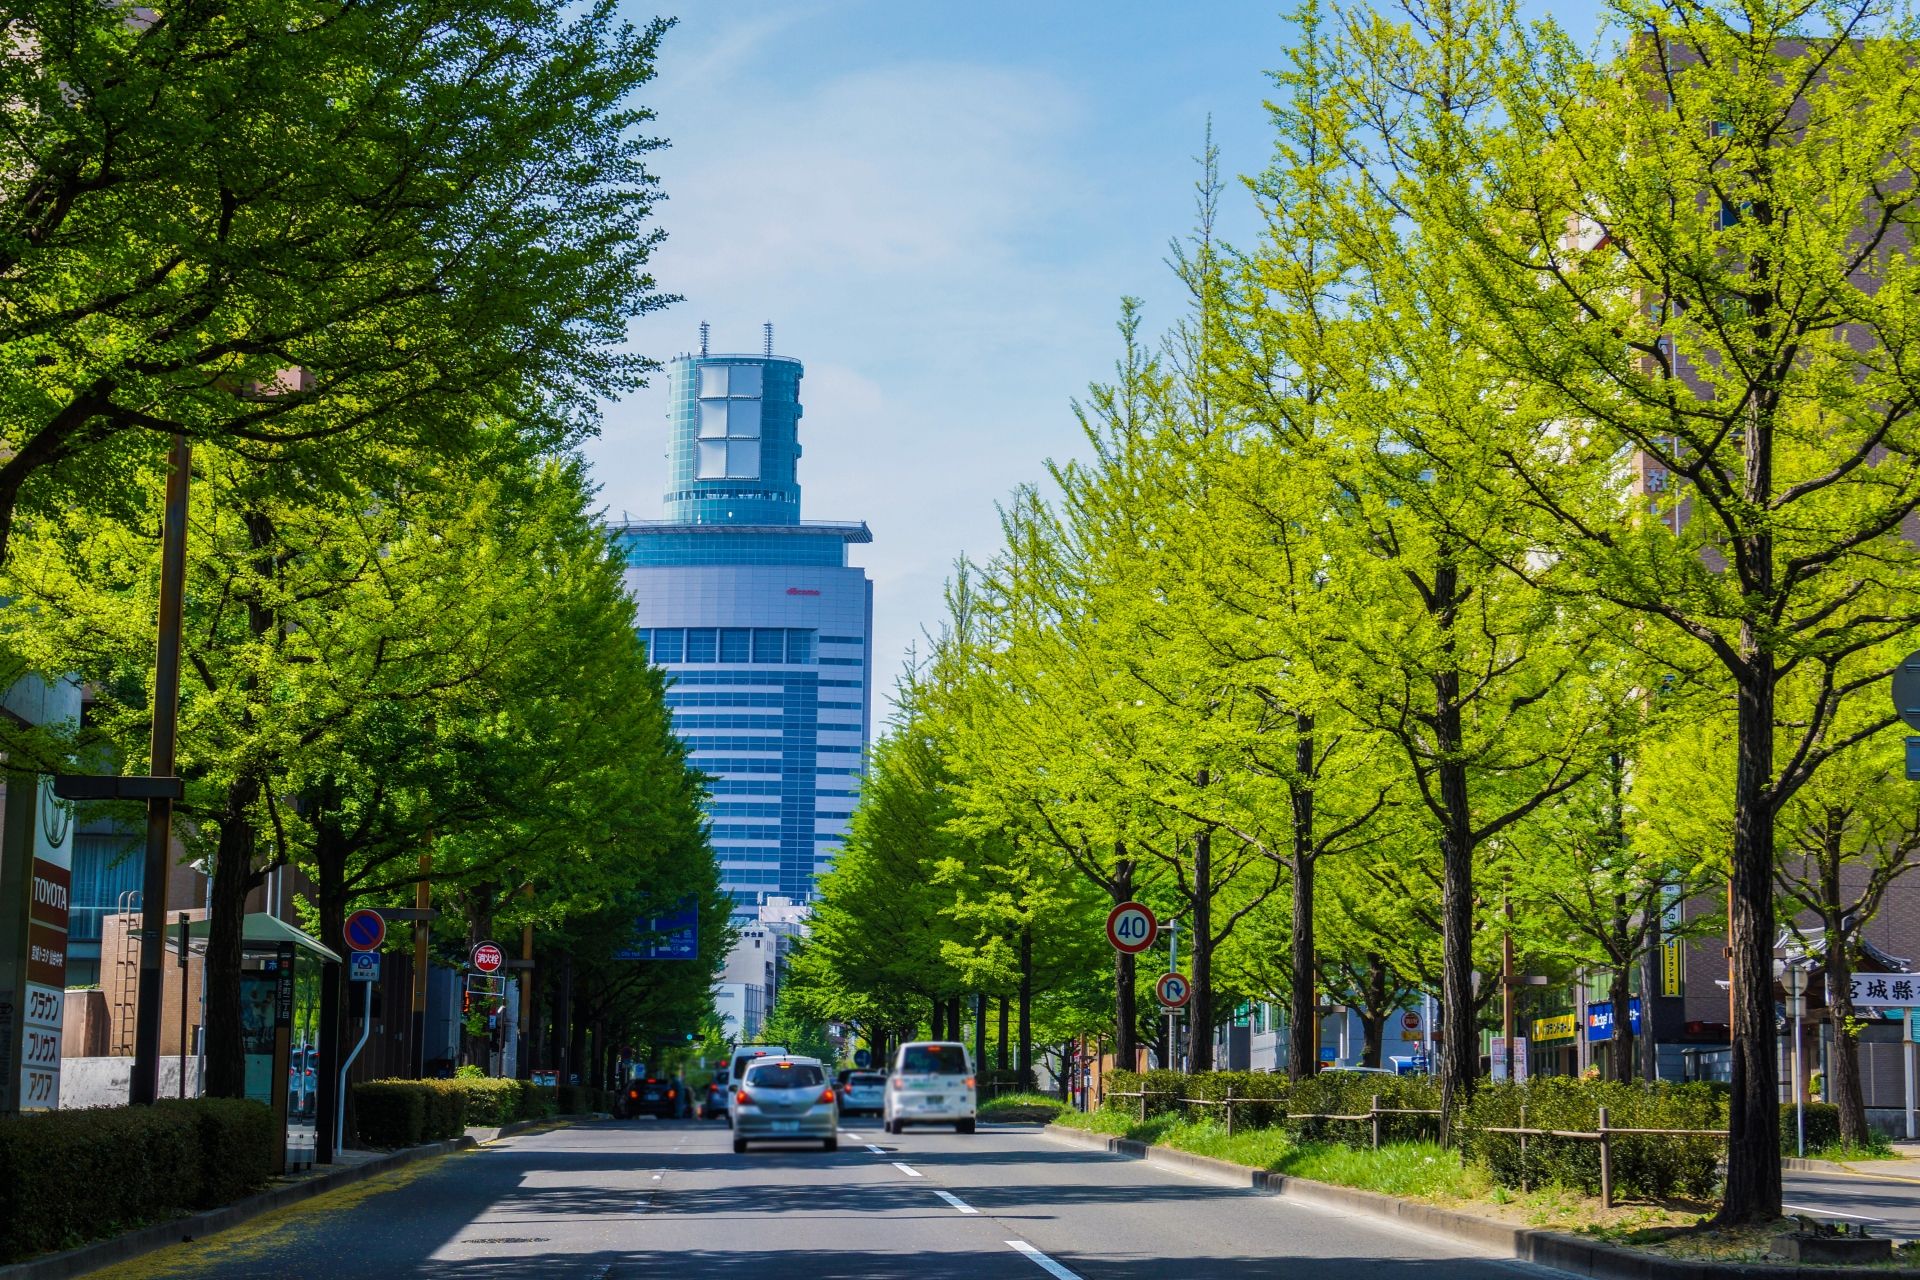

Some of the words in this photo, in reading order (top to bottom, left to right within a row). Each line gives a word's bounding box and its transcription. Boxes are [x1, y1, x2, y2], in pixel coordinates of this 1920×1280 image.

[33, 876, 67, 911] TOYOTA
[1118, 916, 1146, 939] 40
[477, 953, 500, 965] 消火栓
[1849, 979, 1920, 1001] 宮城縣
[30, 991, 59, 1022] クラウン
[28, 1032, 56, 1063] プリウス
[28, 1072, 52, 1102] アクア
